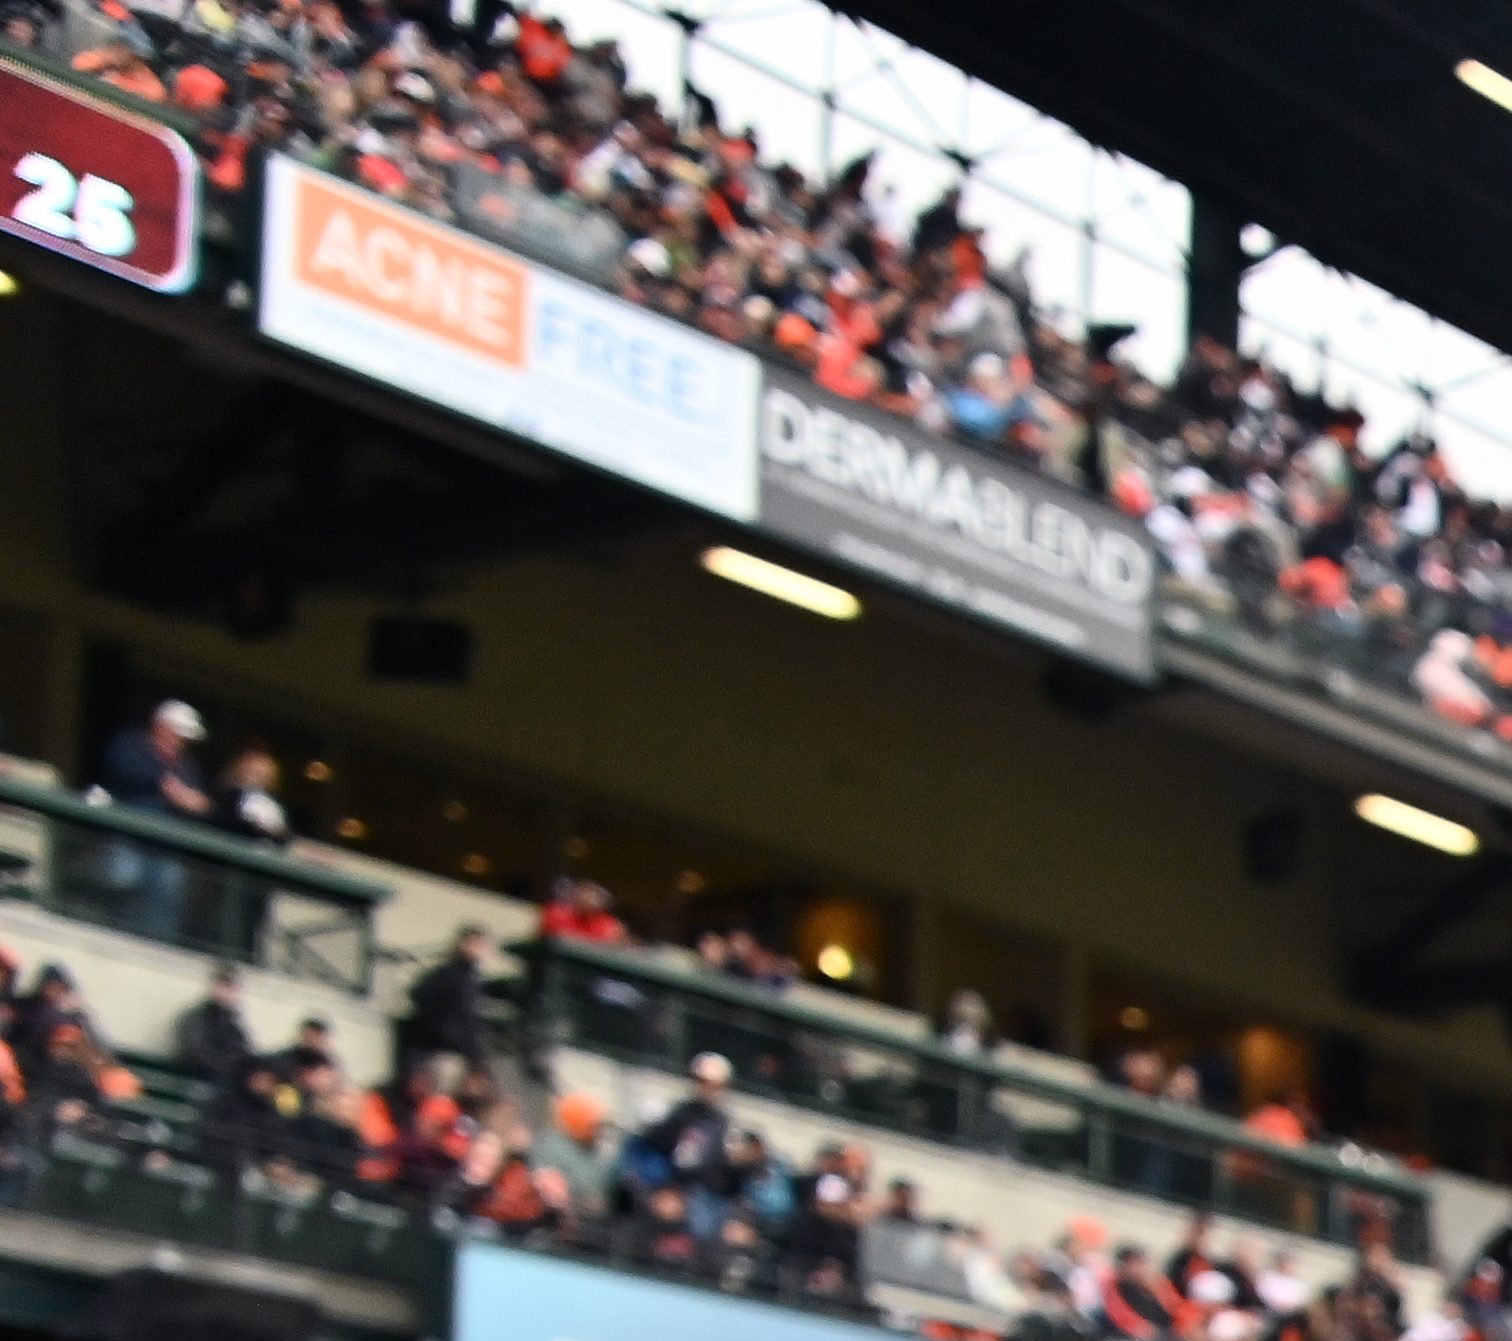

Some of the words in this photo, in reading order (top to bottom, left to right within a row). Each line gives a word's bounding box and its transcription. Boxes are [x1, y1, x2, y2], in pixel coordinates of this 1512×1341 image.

[12, 151, 137, 257] 25
[310, 208, 514, 346] ACNE
[539, 298, 708, 424] FREE
[761, 388, 1152, 600] DERMABLEND
